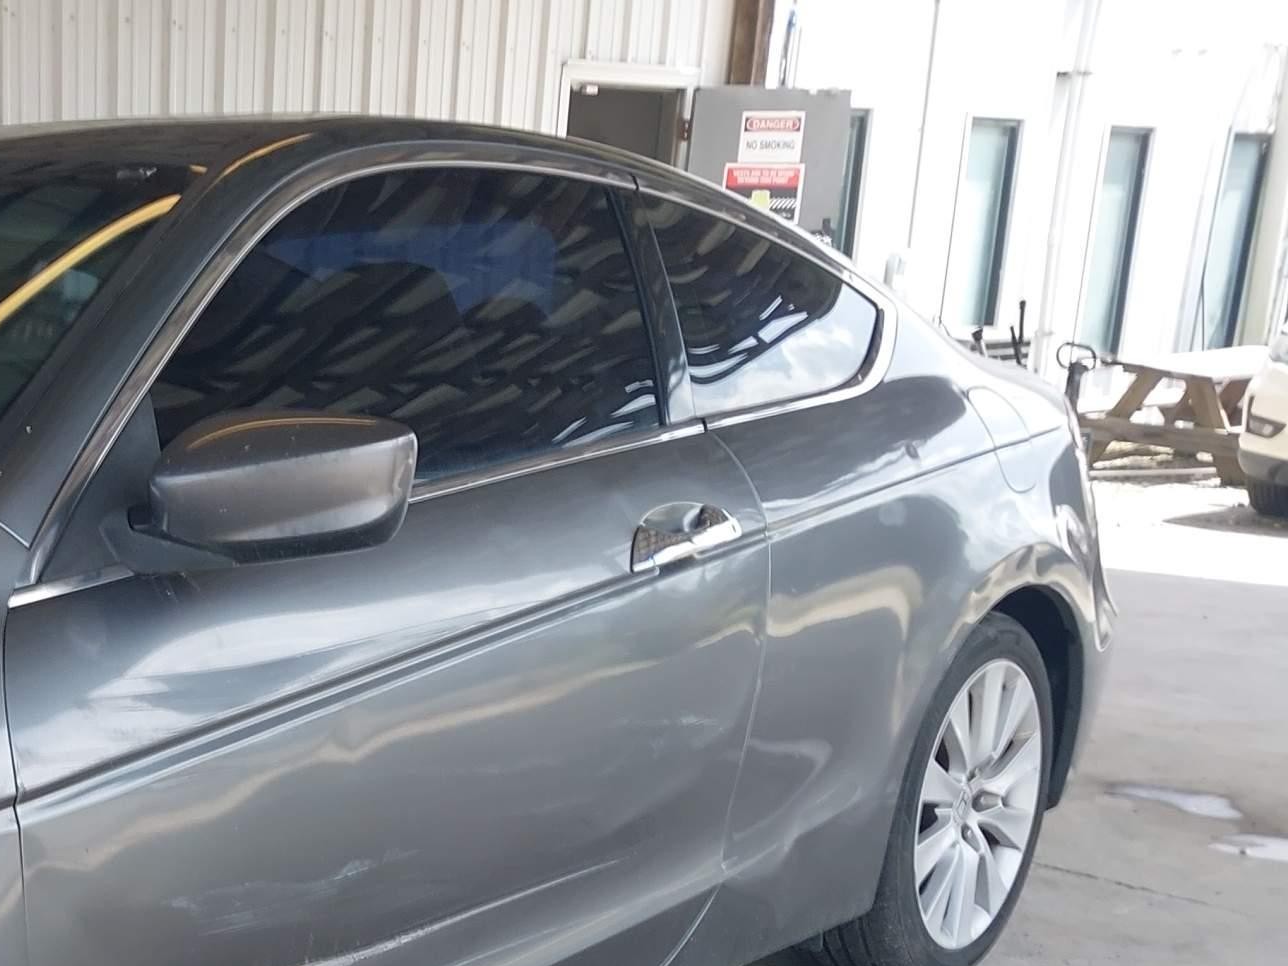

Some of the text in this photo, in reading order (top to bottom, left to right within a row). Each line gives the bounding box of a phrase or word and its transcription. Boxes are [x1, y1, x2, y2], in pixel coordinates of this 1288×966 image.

[752, 118, 794, 130] DANGER
[746, 139, 795, 150] NO SMOKING
